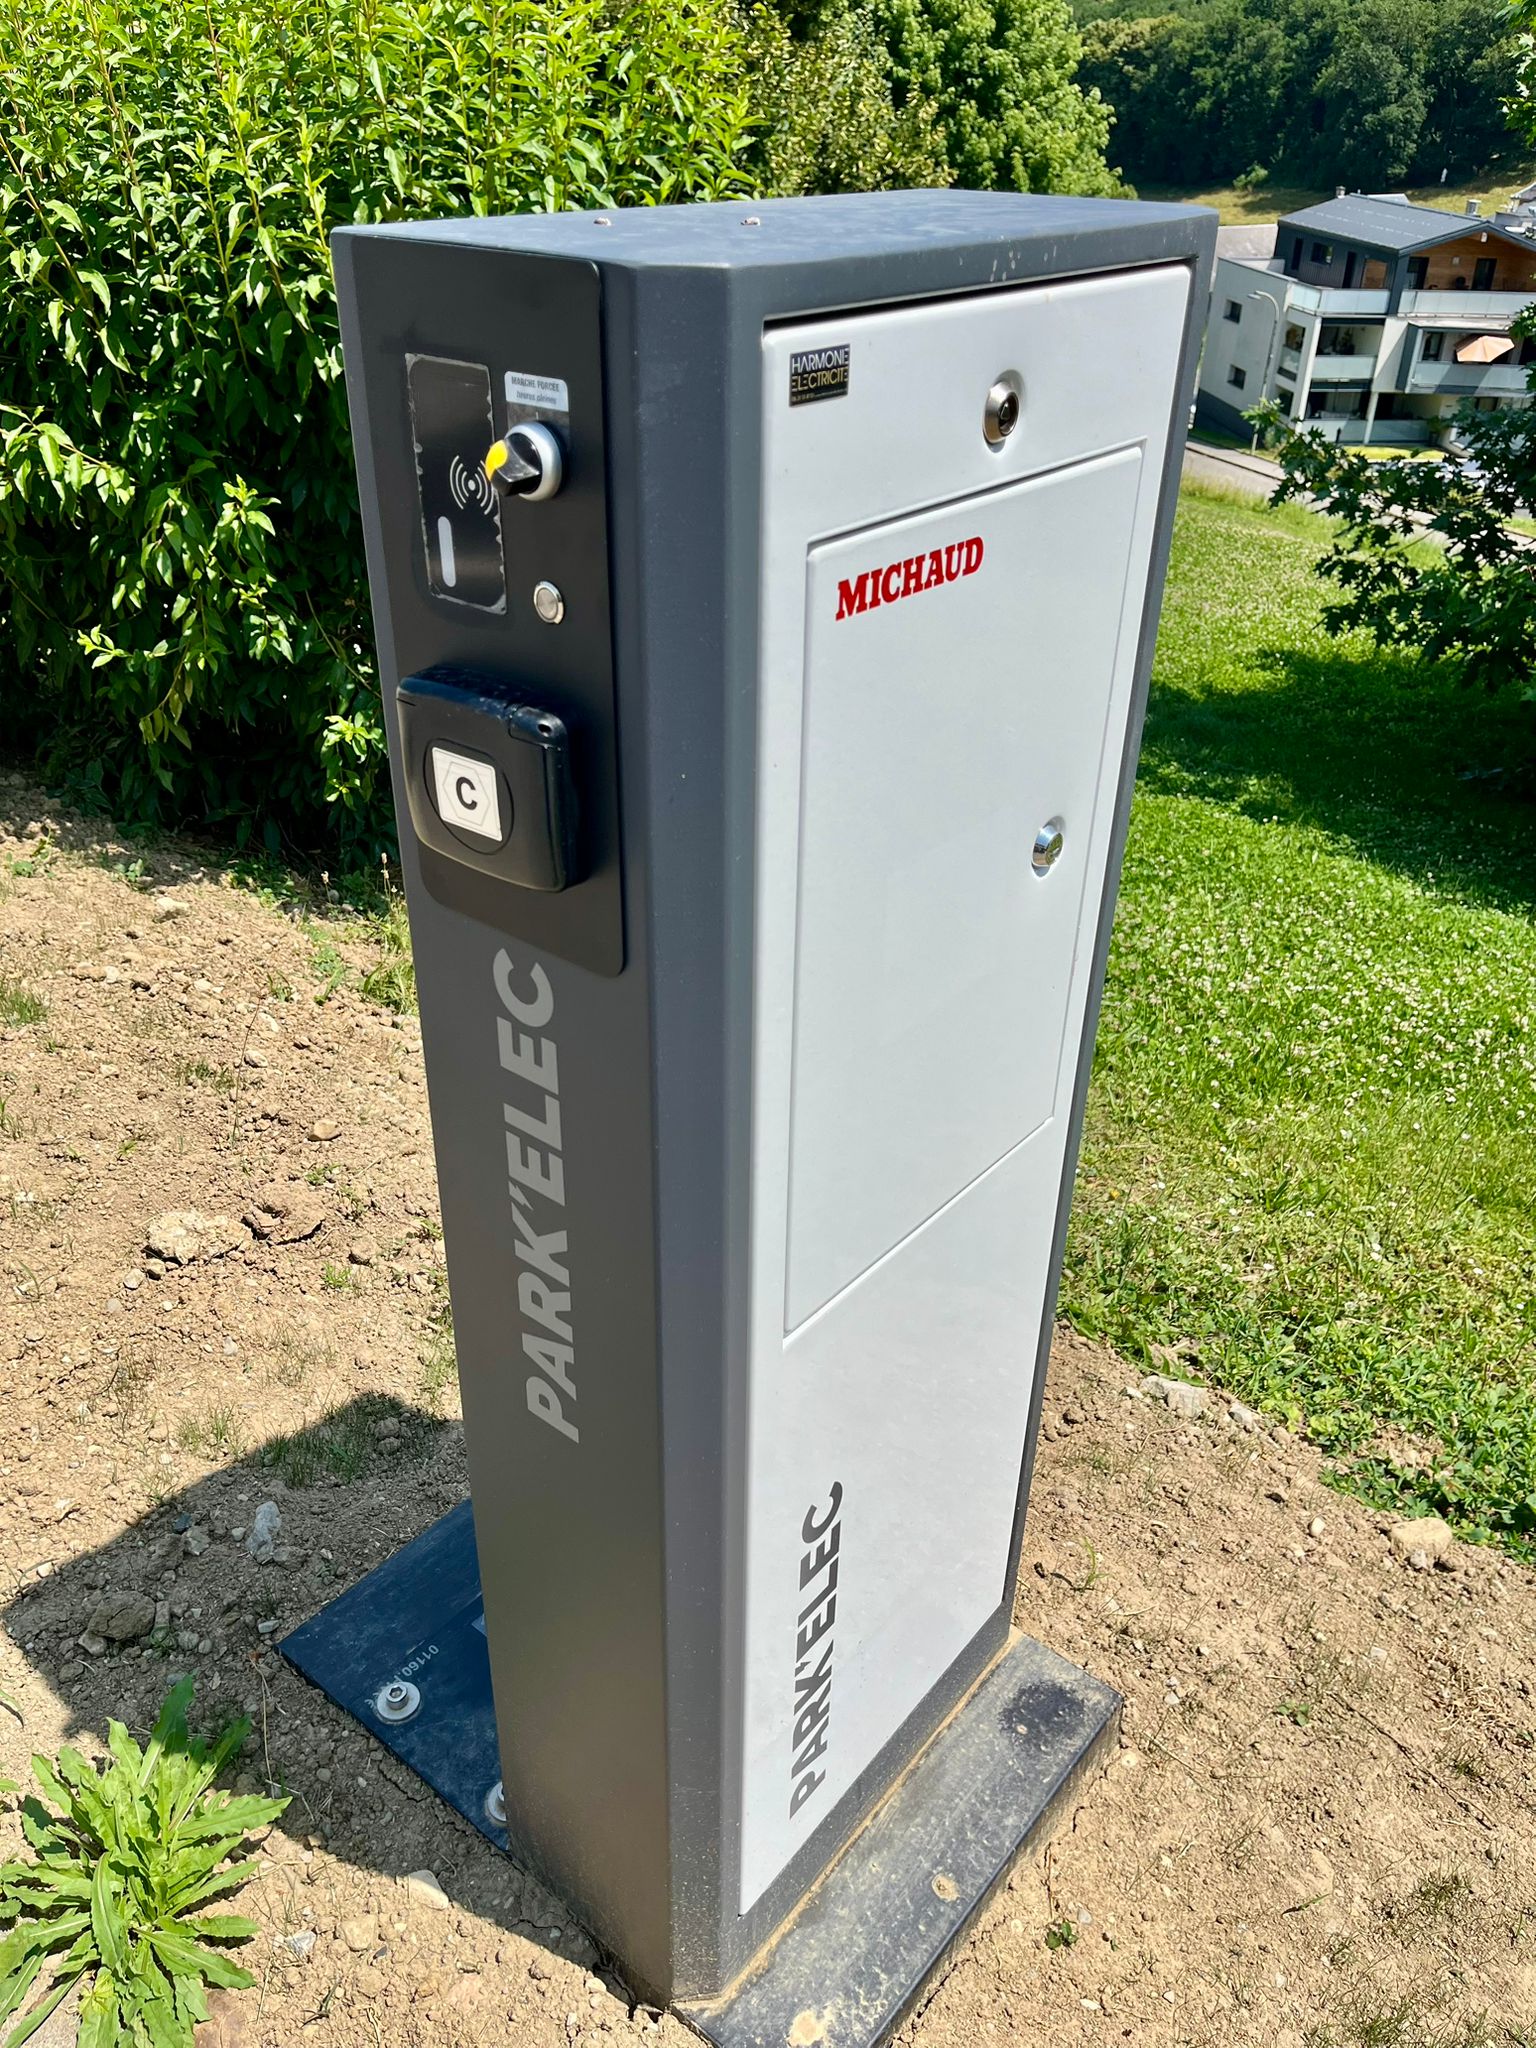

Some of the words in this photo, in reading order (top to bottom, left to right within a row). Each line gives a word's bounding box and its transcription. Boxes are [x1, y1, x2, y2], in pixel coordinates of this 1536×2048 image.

[791, 347, 849, 374] HARMONIE
[835, 536, 984, 621] MICHAUD
[456, 776, 478, 811] C
[493, 948, 580, 1444] PARK'ELEC
[789, 1481, 843, 1820] PARK'ELEC
